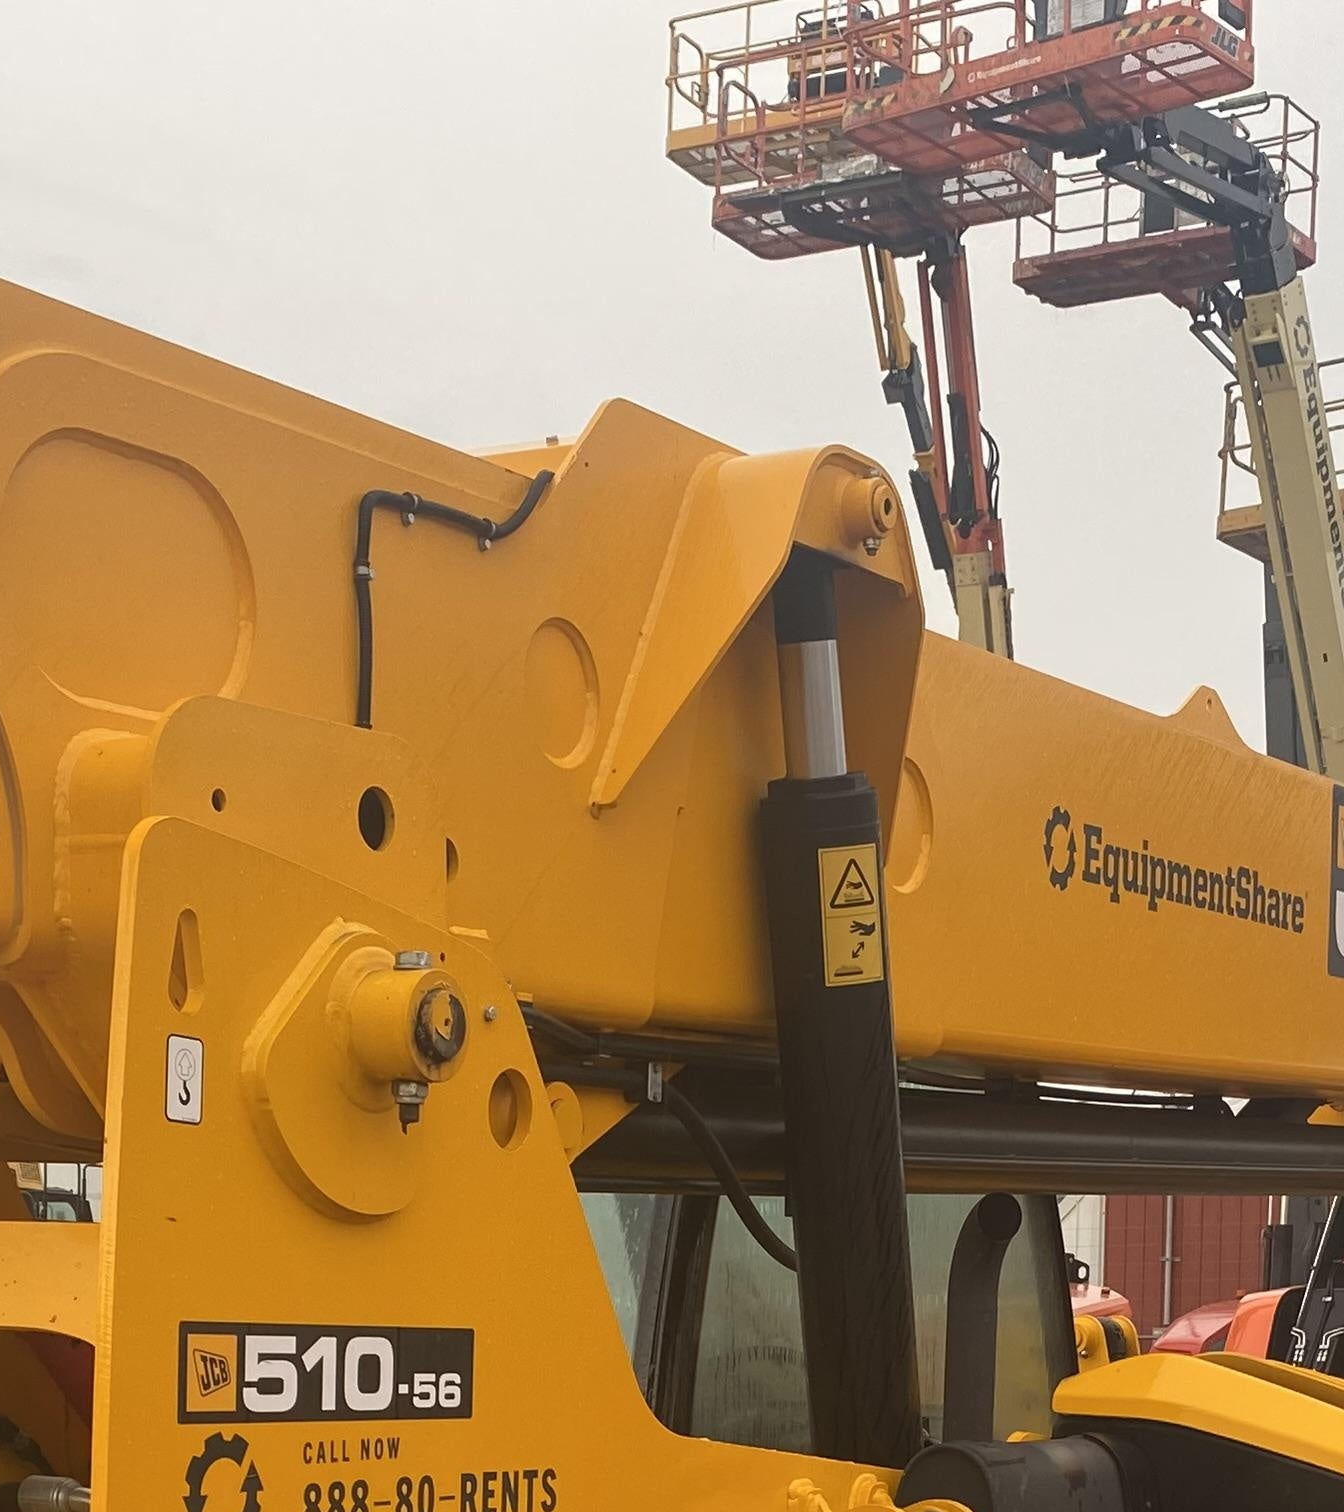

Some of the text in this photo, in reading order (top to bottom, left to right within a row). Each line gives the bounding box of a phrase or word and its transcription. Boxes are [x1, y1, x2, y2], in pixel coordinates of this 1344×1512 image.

[1082, 822, 1304, 934] EquipmentShare
[199, 1354, 230, 1391] JCB
[242, 1333, 462, 1413] 510-56
[303, 1437, 401, 1464] CALL NOW
